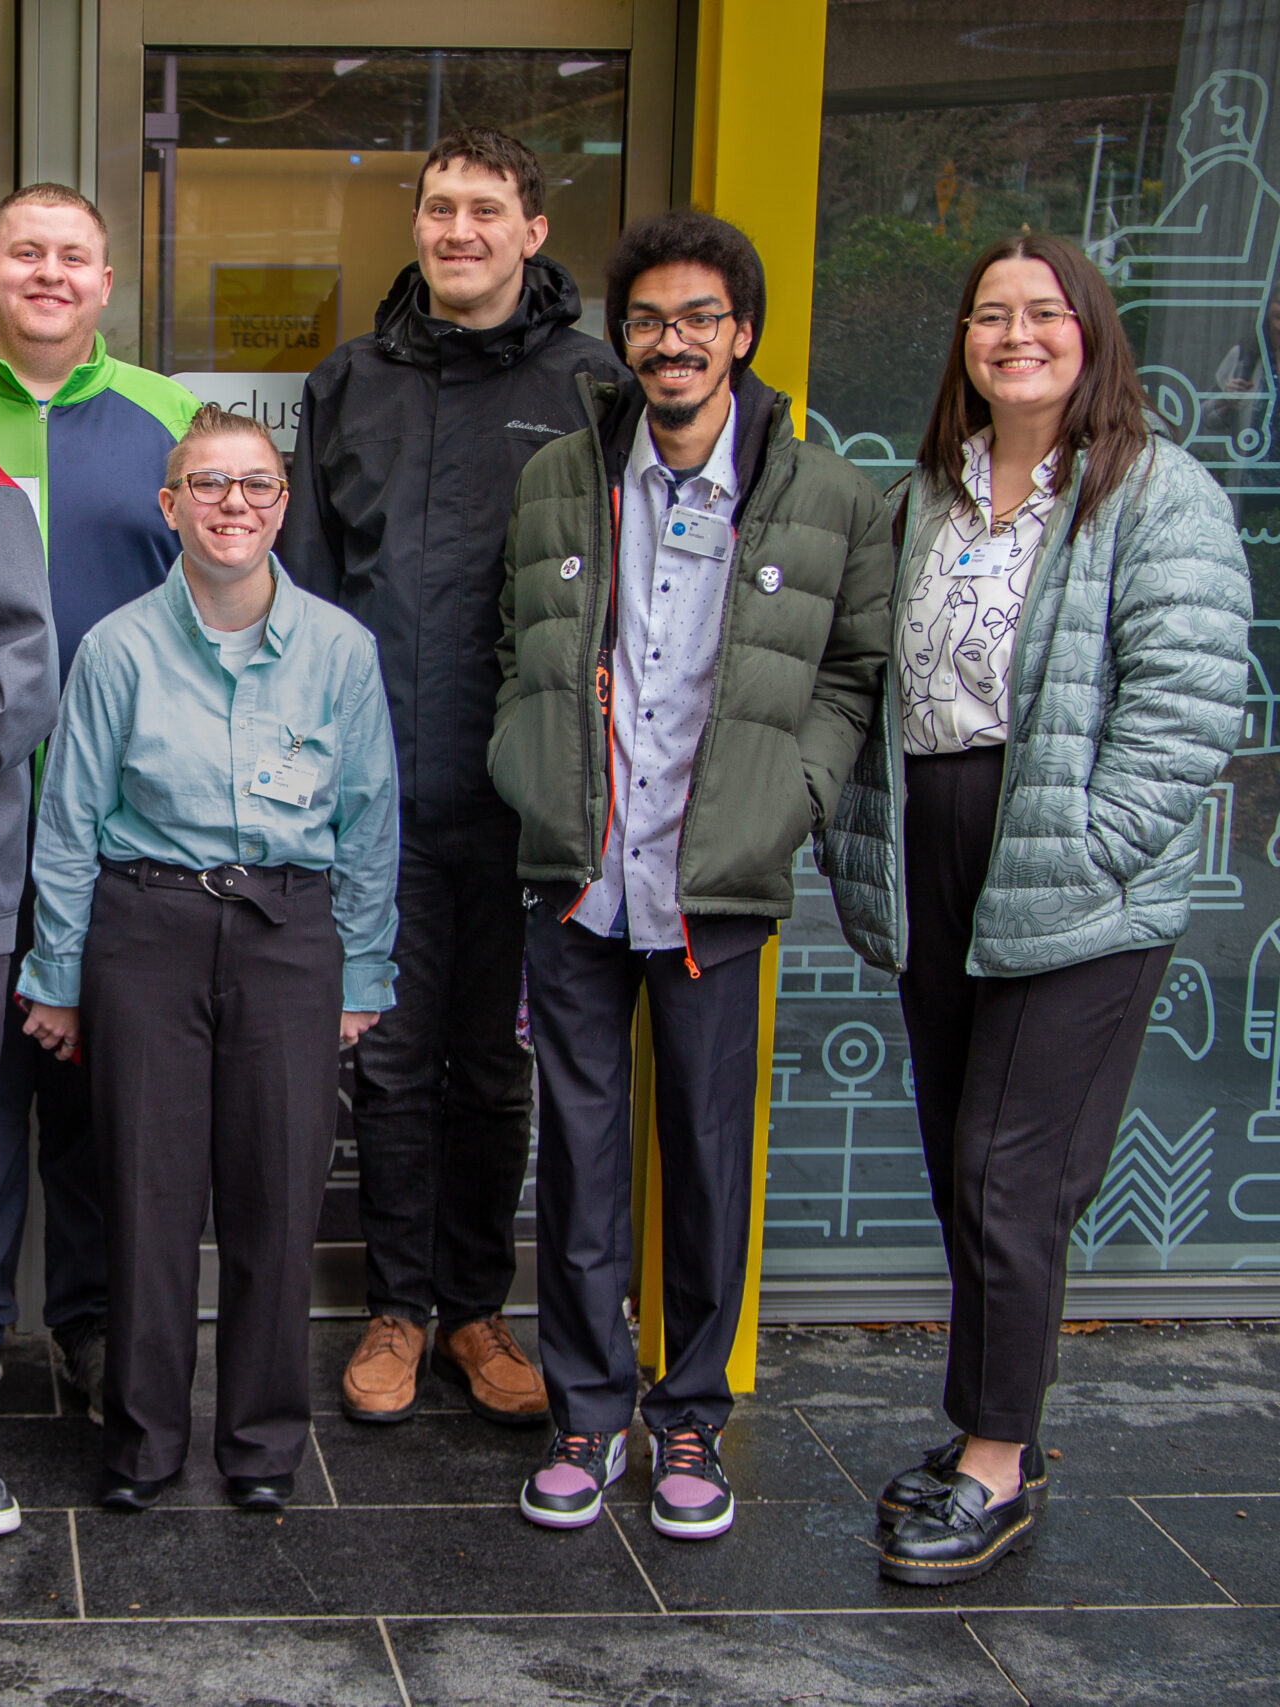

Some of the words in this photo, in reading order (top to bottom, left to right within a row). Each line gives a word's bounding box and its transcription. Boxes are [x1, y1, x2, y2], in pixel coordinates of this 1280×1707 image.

[228, 314, 320, 331] INCLUSIVE
[231, 332, 279, 348] TECH
[284, 332, 320, 349] LAB
